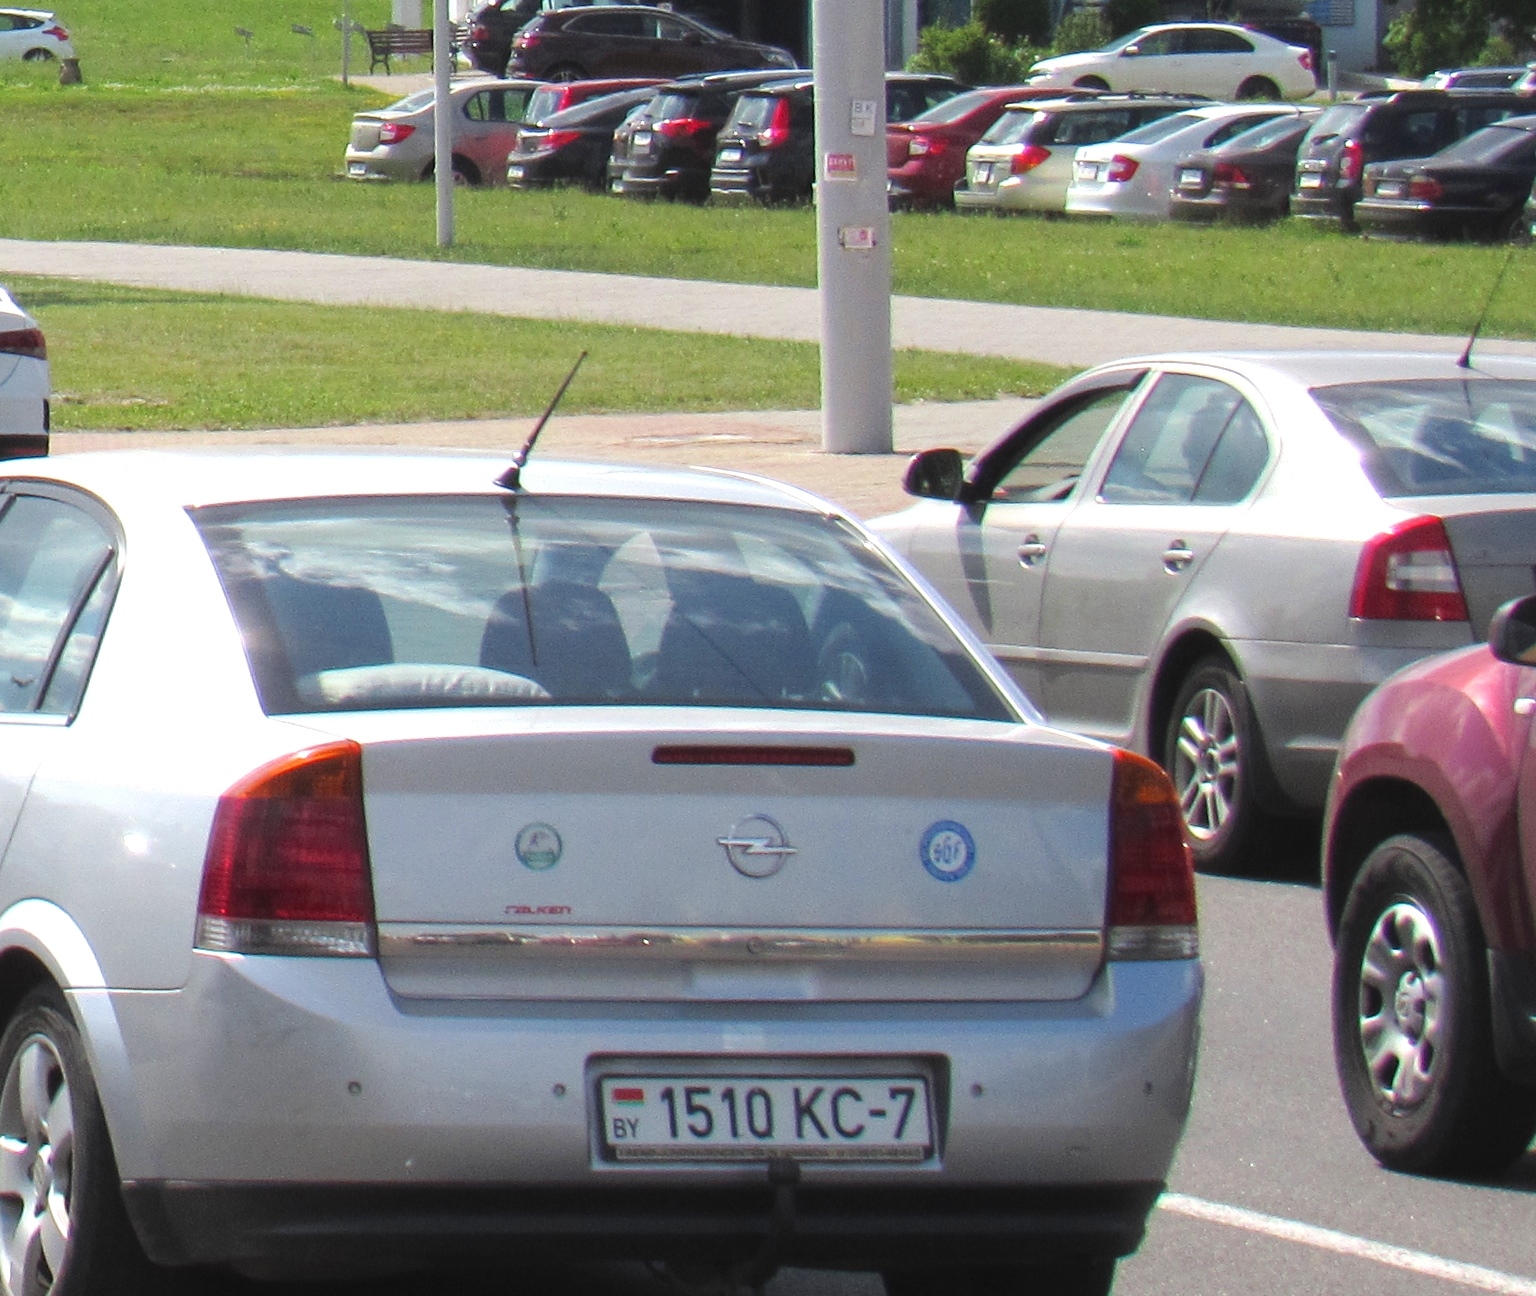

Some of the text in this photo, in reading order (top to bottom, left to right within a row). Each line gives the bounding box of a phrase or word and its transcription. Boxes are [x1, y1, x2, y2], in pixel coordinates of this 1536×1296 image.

[612, 1086, 916, 1140] BY 1510 KC-7
